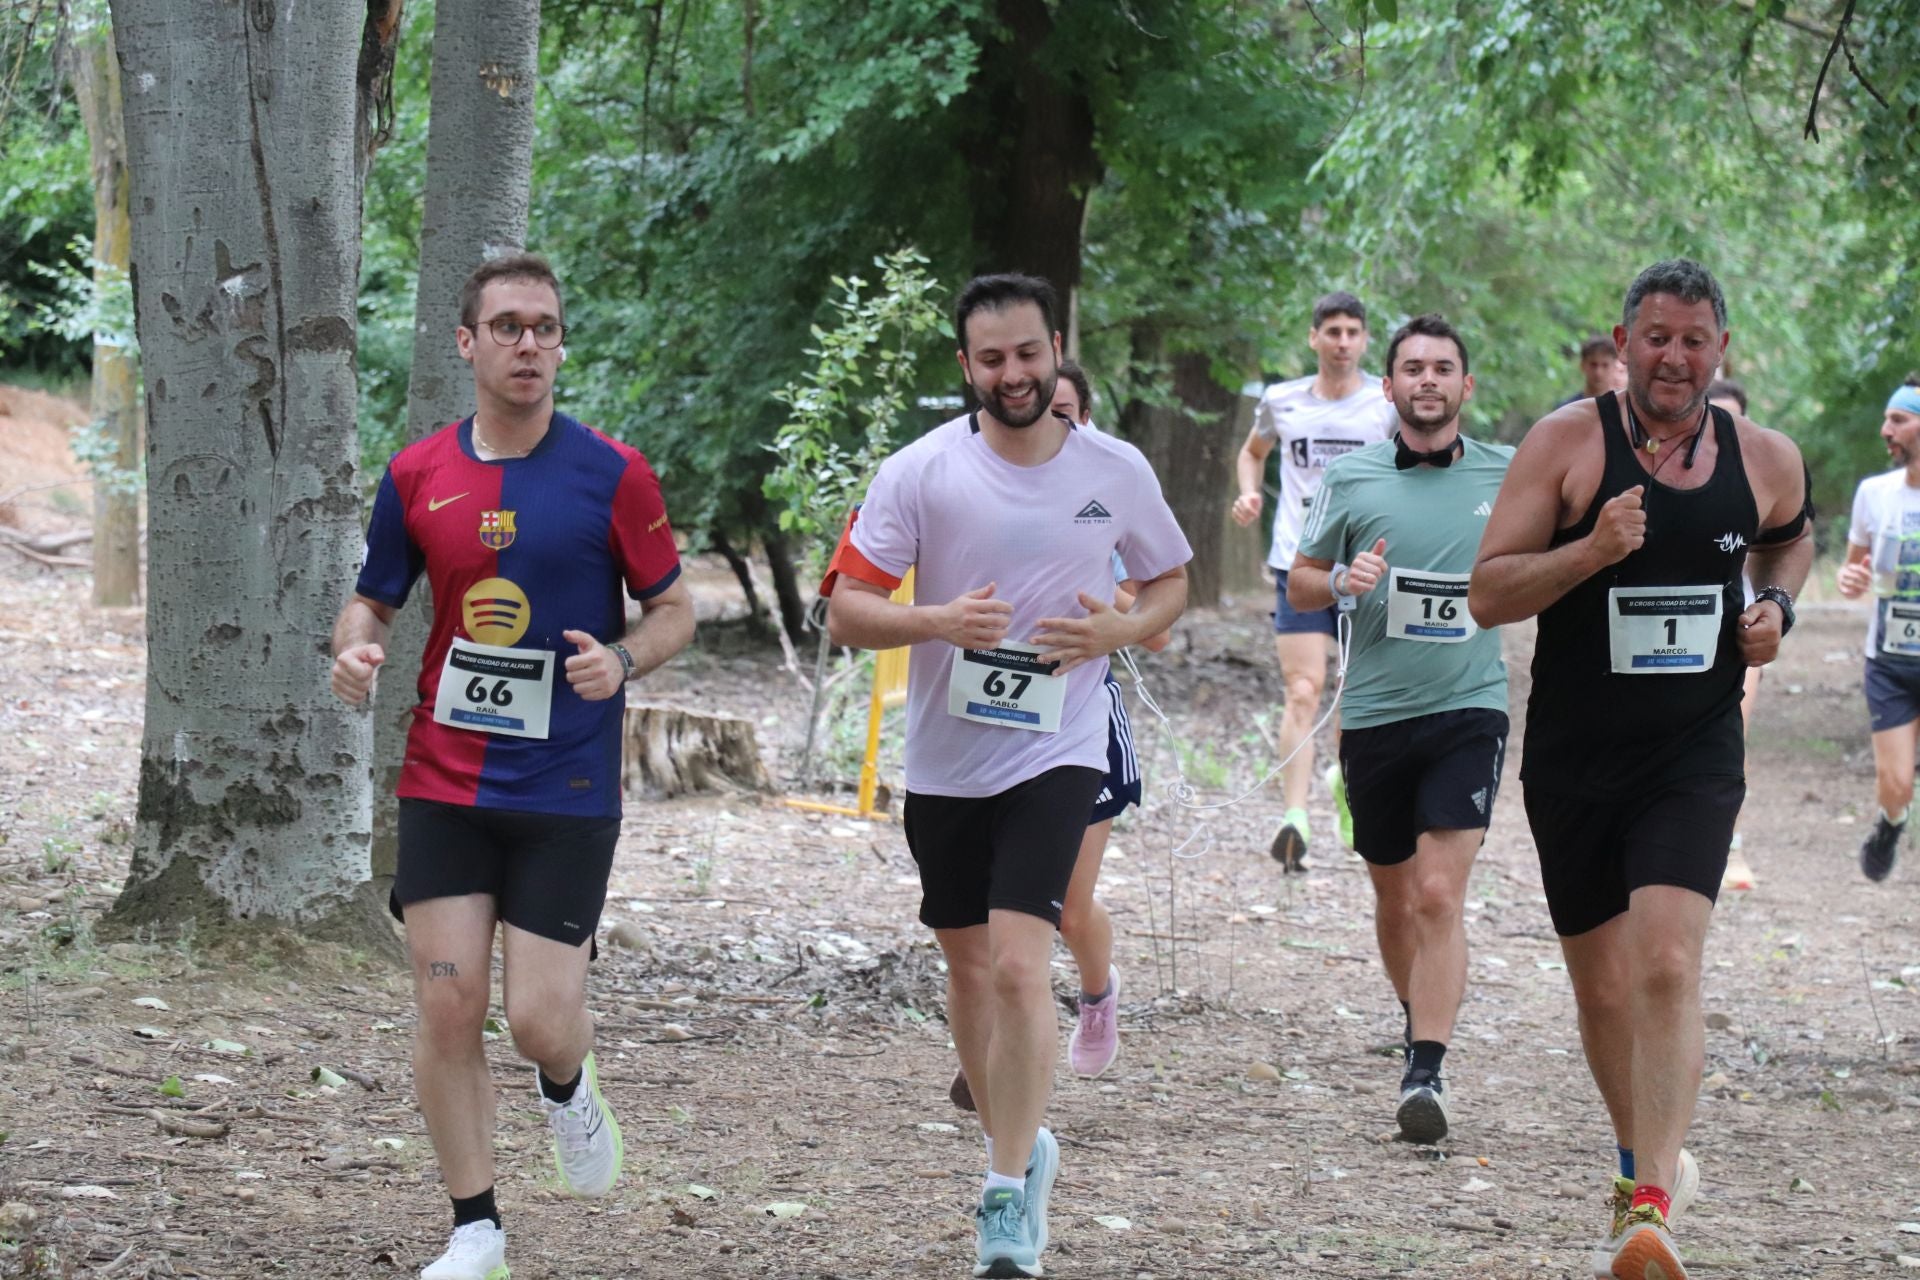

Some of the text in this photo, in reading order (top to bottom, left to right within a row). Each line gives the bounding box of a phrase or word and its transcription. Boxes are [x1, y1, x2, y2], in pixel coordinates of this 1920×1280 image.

[1421, 597, 1457, 621] 16
[1664, 618, 1677, 646] 1
[1903, 622, 1920, 639] 6
[977, 648, 997, 658] CROSS
[997, 652, 1020, 661] CIUDAD
[1653, 647, 1688, 655] MARCOS
[477, 657, 500, 667] CIUDAD
[509, 662, 534, 670] ALFARO
[465, 675, 513, 707] 66
[982, 670, 1032, 701] 67
[475, 705, 498, 715] RAÚL
[990, 699, 1018, 709] PABLO
